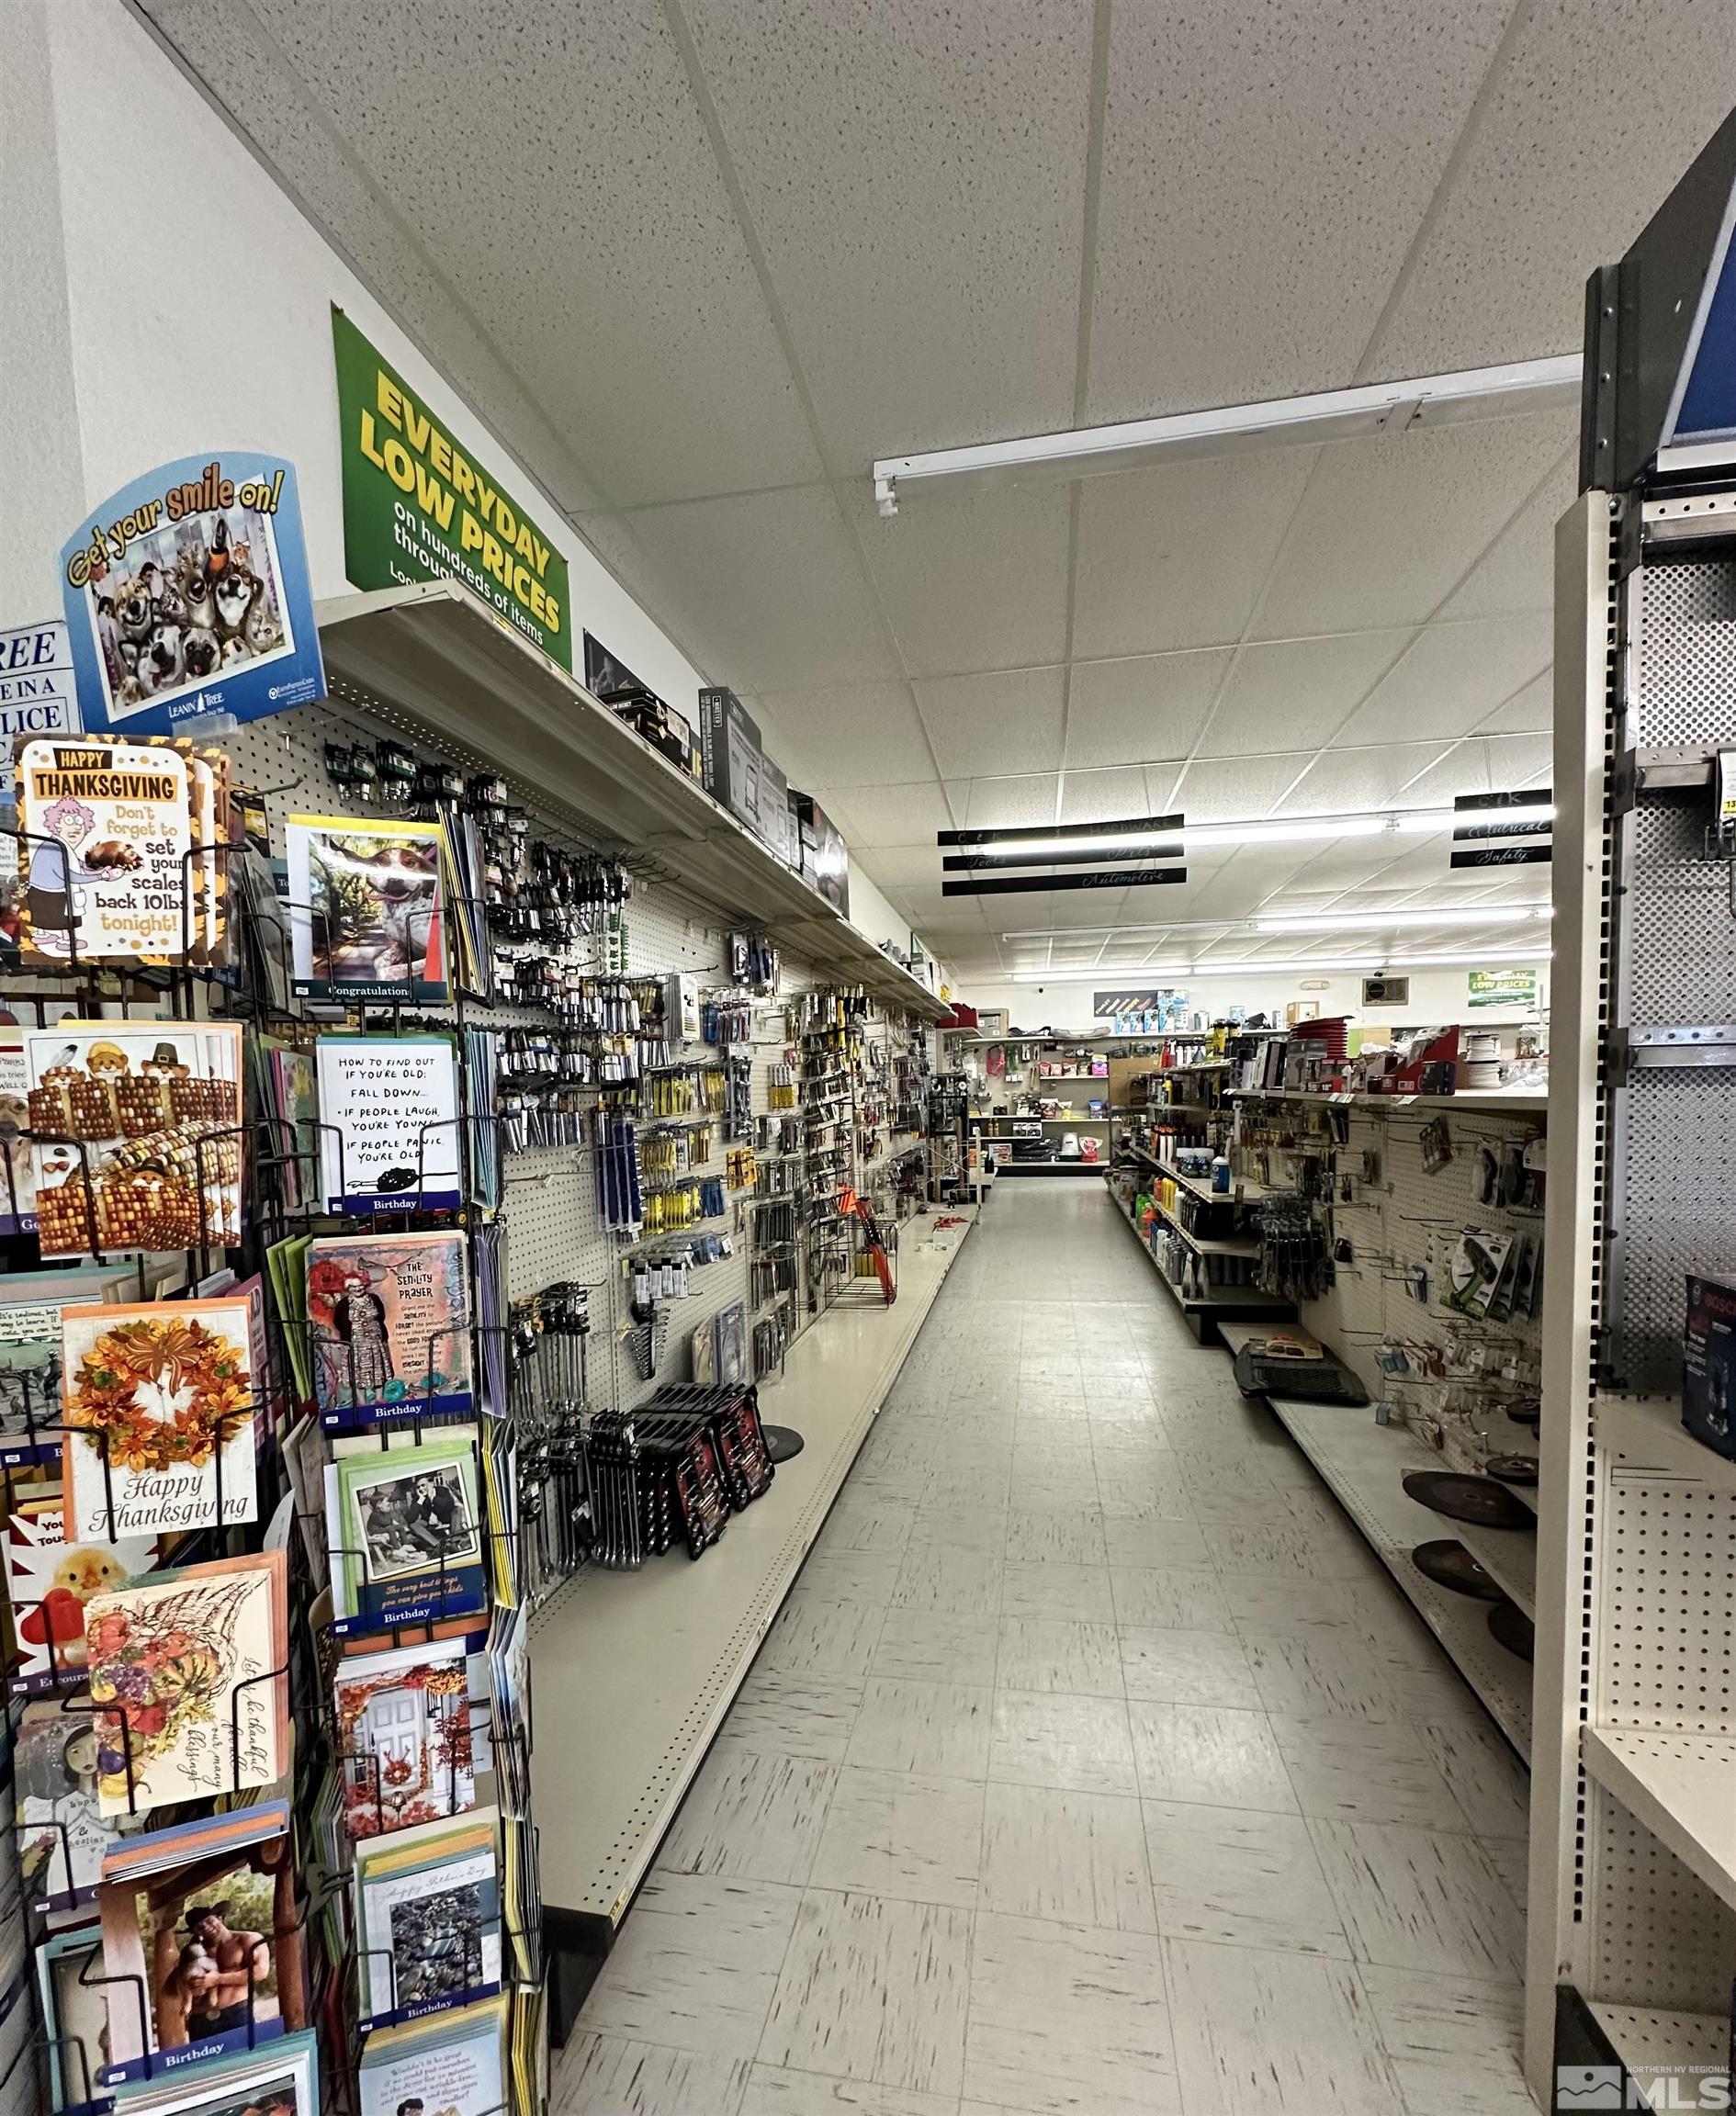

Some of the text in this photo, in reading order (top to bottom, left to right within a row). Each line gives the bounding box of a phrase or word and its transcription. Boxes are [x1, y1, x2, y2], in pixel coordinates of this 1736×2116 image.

[378, 369, 550, 579] EVERYDAY
[67, 462, 286, 589] Get your smile on!
[361, 408, 559, 633] LOW PRICES
[394, 523, 454, 580] throug
[394, 501, 416, 533] on
[422, 520, 490, 599] hundreds
[494, 593, 508, 613] of
[511, 602, 543, 645] items
[17, 679, 37, 698] IN
[42, 677, 55, 694] A
[205, 692, 225, 704] TREE
[61, 750, 106, 769] HAPPY
[36, 773, 175, 800] THANKSGIVING
[116, 805, 155, 819] Don't
[107, 820, 177, 839] forget to
[145, 839, 175, 855] set
[1476, 848, 1536, 864] Safety
[152, 859, 184, 872] your
[1083, 870, 1166, 887] Automotive
[96, 893, 137, 909] back
[101, 914, 177, 936] tonight!
[329, 985, 410, 996] Congratulation
[1472, 980, 1530, 989] LOW PRICES
[339, 1058, 435, 1067] HOW TO FIND OUT
[345, 1070, 355, 1080] IF
[360, 1069, 398, 1079] YOU'RE
[351, 1088, 379, 1098] FALL
[344, 1108, 355, 1118] IF
[360, 1108, 400, 1118] PEOPLE
[352, 1121, 389, 1131] YOU'RE
[346, 1142, 356, 1151] IF
[361, 1140, 400, 1150] PEOPLE
[357, 1152, 394, 1165] YOU'RE
[374, 1199, 417, 1210] Birthday
[407, 1262, 423, 1272] THE
[375, 1404, 423, 1418] Birthday
[123, 1474, 204, 1502] Happy
[88, 1496, 248, 1532] Thanksgivng
[384, 1608, 431, 1624] Birthday
[407, 1999, 453, 2020] Birthday
[165, 2042, 225, 2068] Birthday
